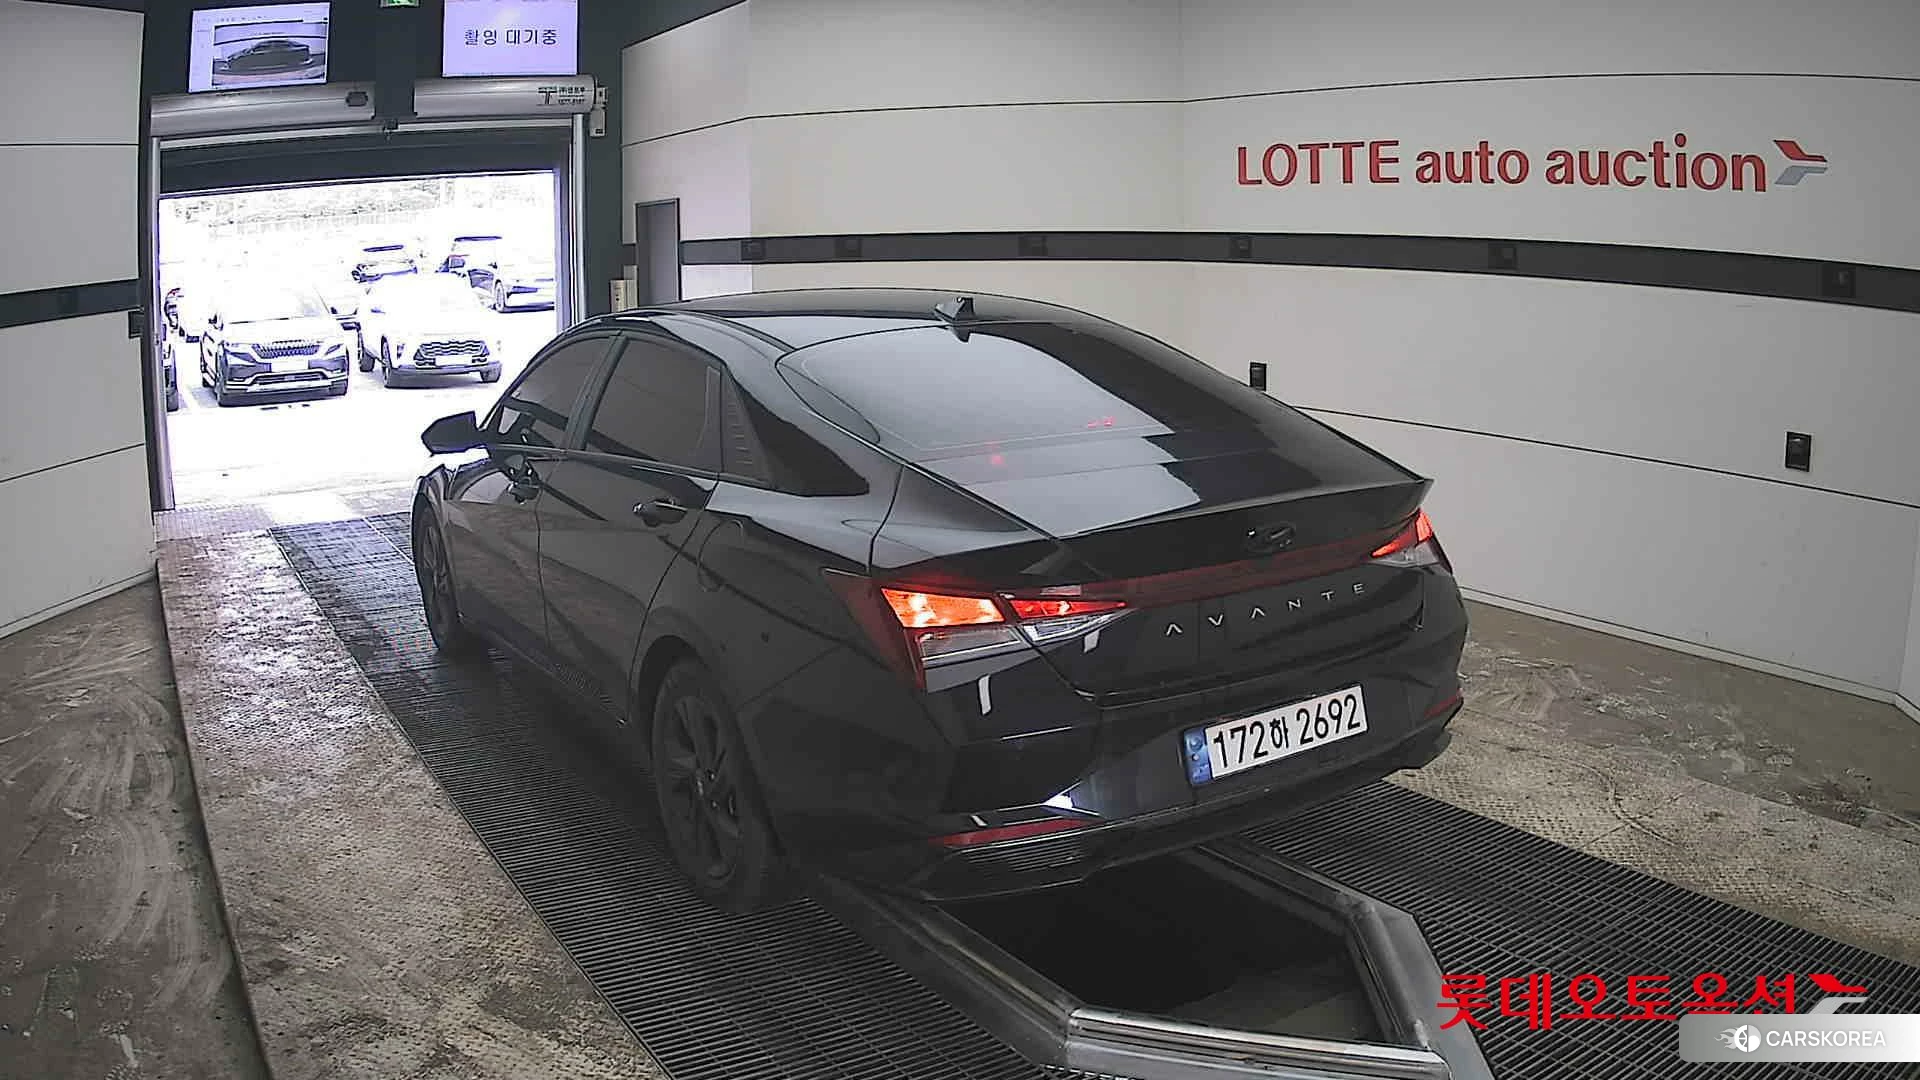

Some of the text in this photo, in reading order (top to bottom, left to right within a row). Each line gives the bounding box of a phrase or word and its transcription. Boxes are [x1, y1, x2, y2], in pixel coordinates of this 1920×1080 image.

[505, 29, 558, 46] 대기중
[1238, 132, 1767, 193] LOTTE auto auction
[1166, 582, 1366, 637] AVANTE
[1213, 693, 1361, 769] 172하 2692
